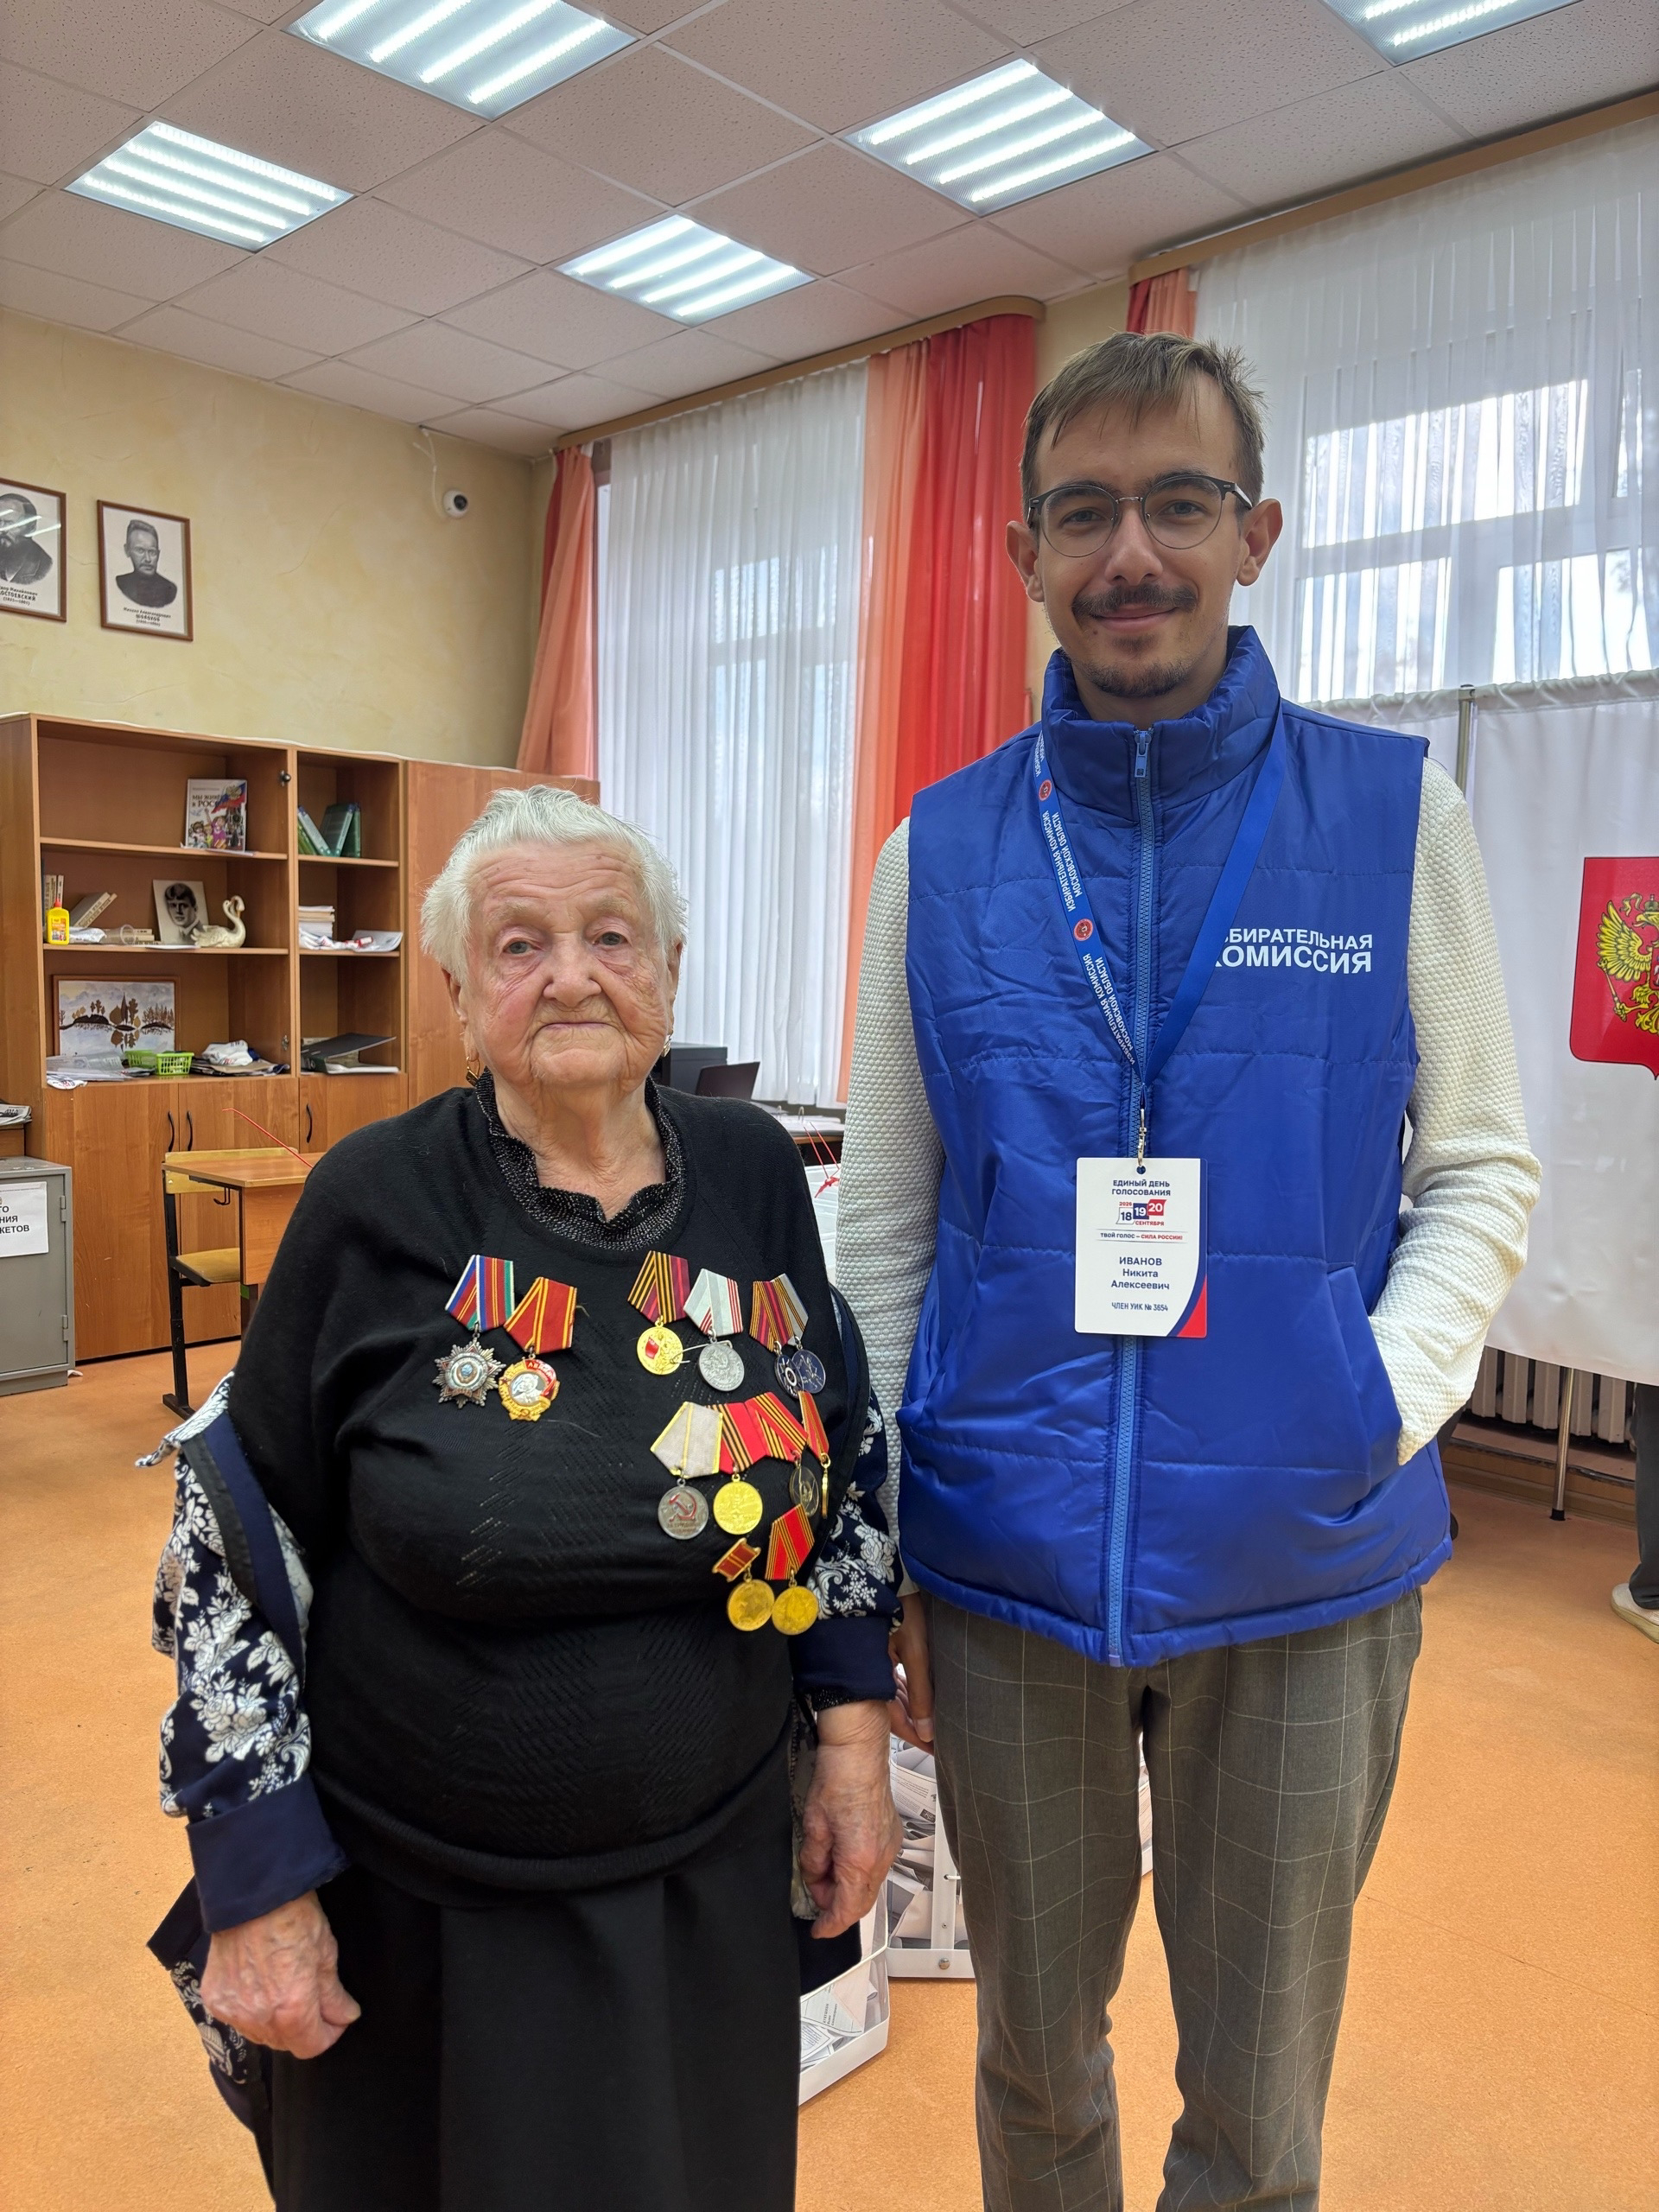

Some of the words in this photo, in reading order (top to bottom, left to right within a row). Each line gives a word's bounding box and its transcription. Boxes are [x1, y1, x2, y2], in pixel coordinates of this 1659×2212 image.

[1041, 810, 1057, 851] КОМИССИЯ
[1052, 812, 1068, 847] ОБЛАСТИ
[1052, 850, 1077, 912] ИЗБИРАТЕЛЬНАЯ
[1061, 845, 1083, 898] МОСКОВСКОЙ
[1224, 928, 1373, 950] БИРАТЕЛЬНАЯ
[1215, 945, 1372, 974] ОМИССИЯ
[1083, 953, 1106, 1000] КОМИССИЯ
[1095, 957, 1114, 996] ОБЛАСТИ
[1100, 997, 1135, 1065] ИЗБИРАТЕЛЬНАЯ
[1107, 994, 1134, 1052] МОСКОВСКОЙ
[1113, 1179, 1147, 1187] ЕДИНЫЙ
[1121, 1211, 1132, 1221] 18
[1134, 1206, 1147, 1217] 19
[1148, 1202, 1163, 1212] 20
[1119, 1256, 1162, 1266] ИВАНОВ
[1122, 1268, 1159, 1278] Никита
[1110, 1280, 1170, 1289] Алексеевич
[1111, 1301, 1128, 1310] ЧЛЕН
[1130, 1302, 1143, 1311] УИК
